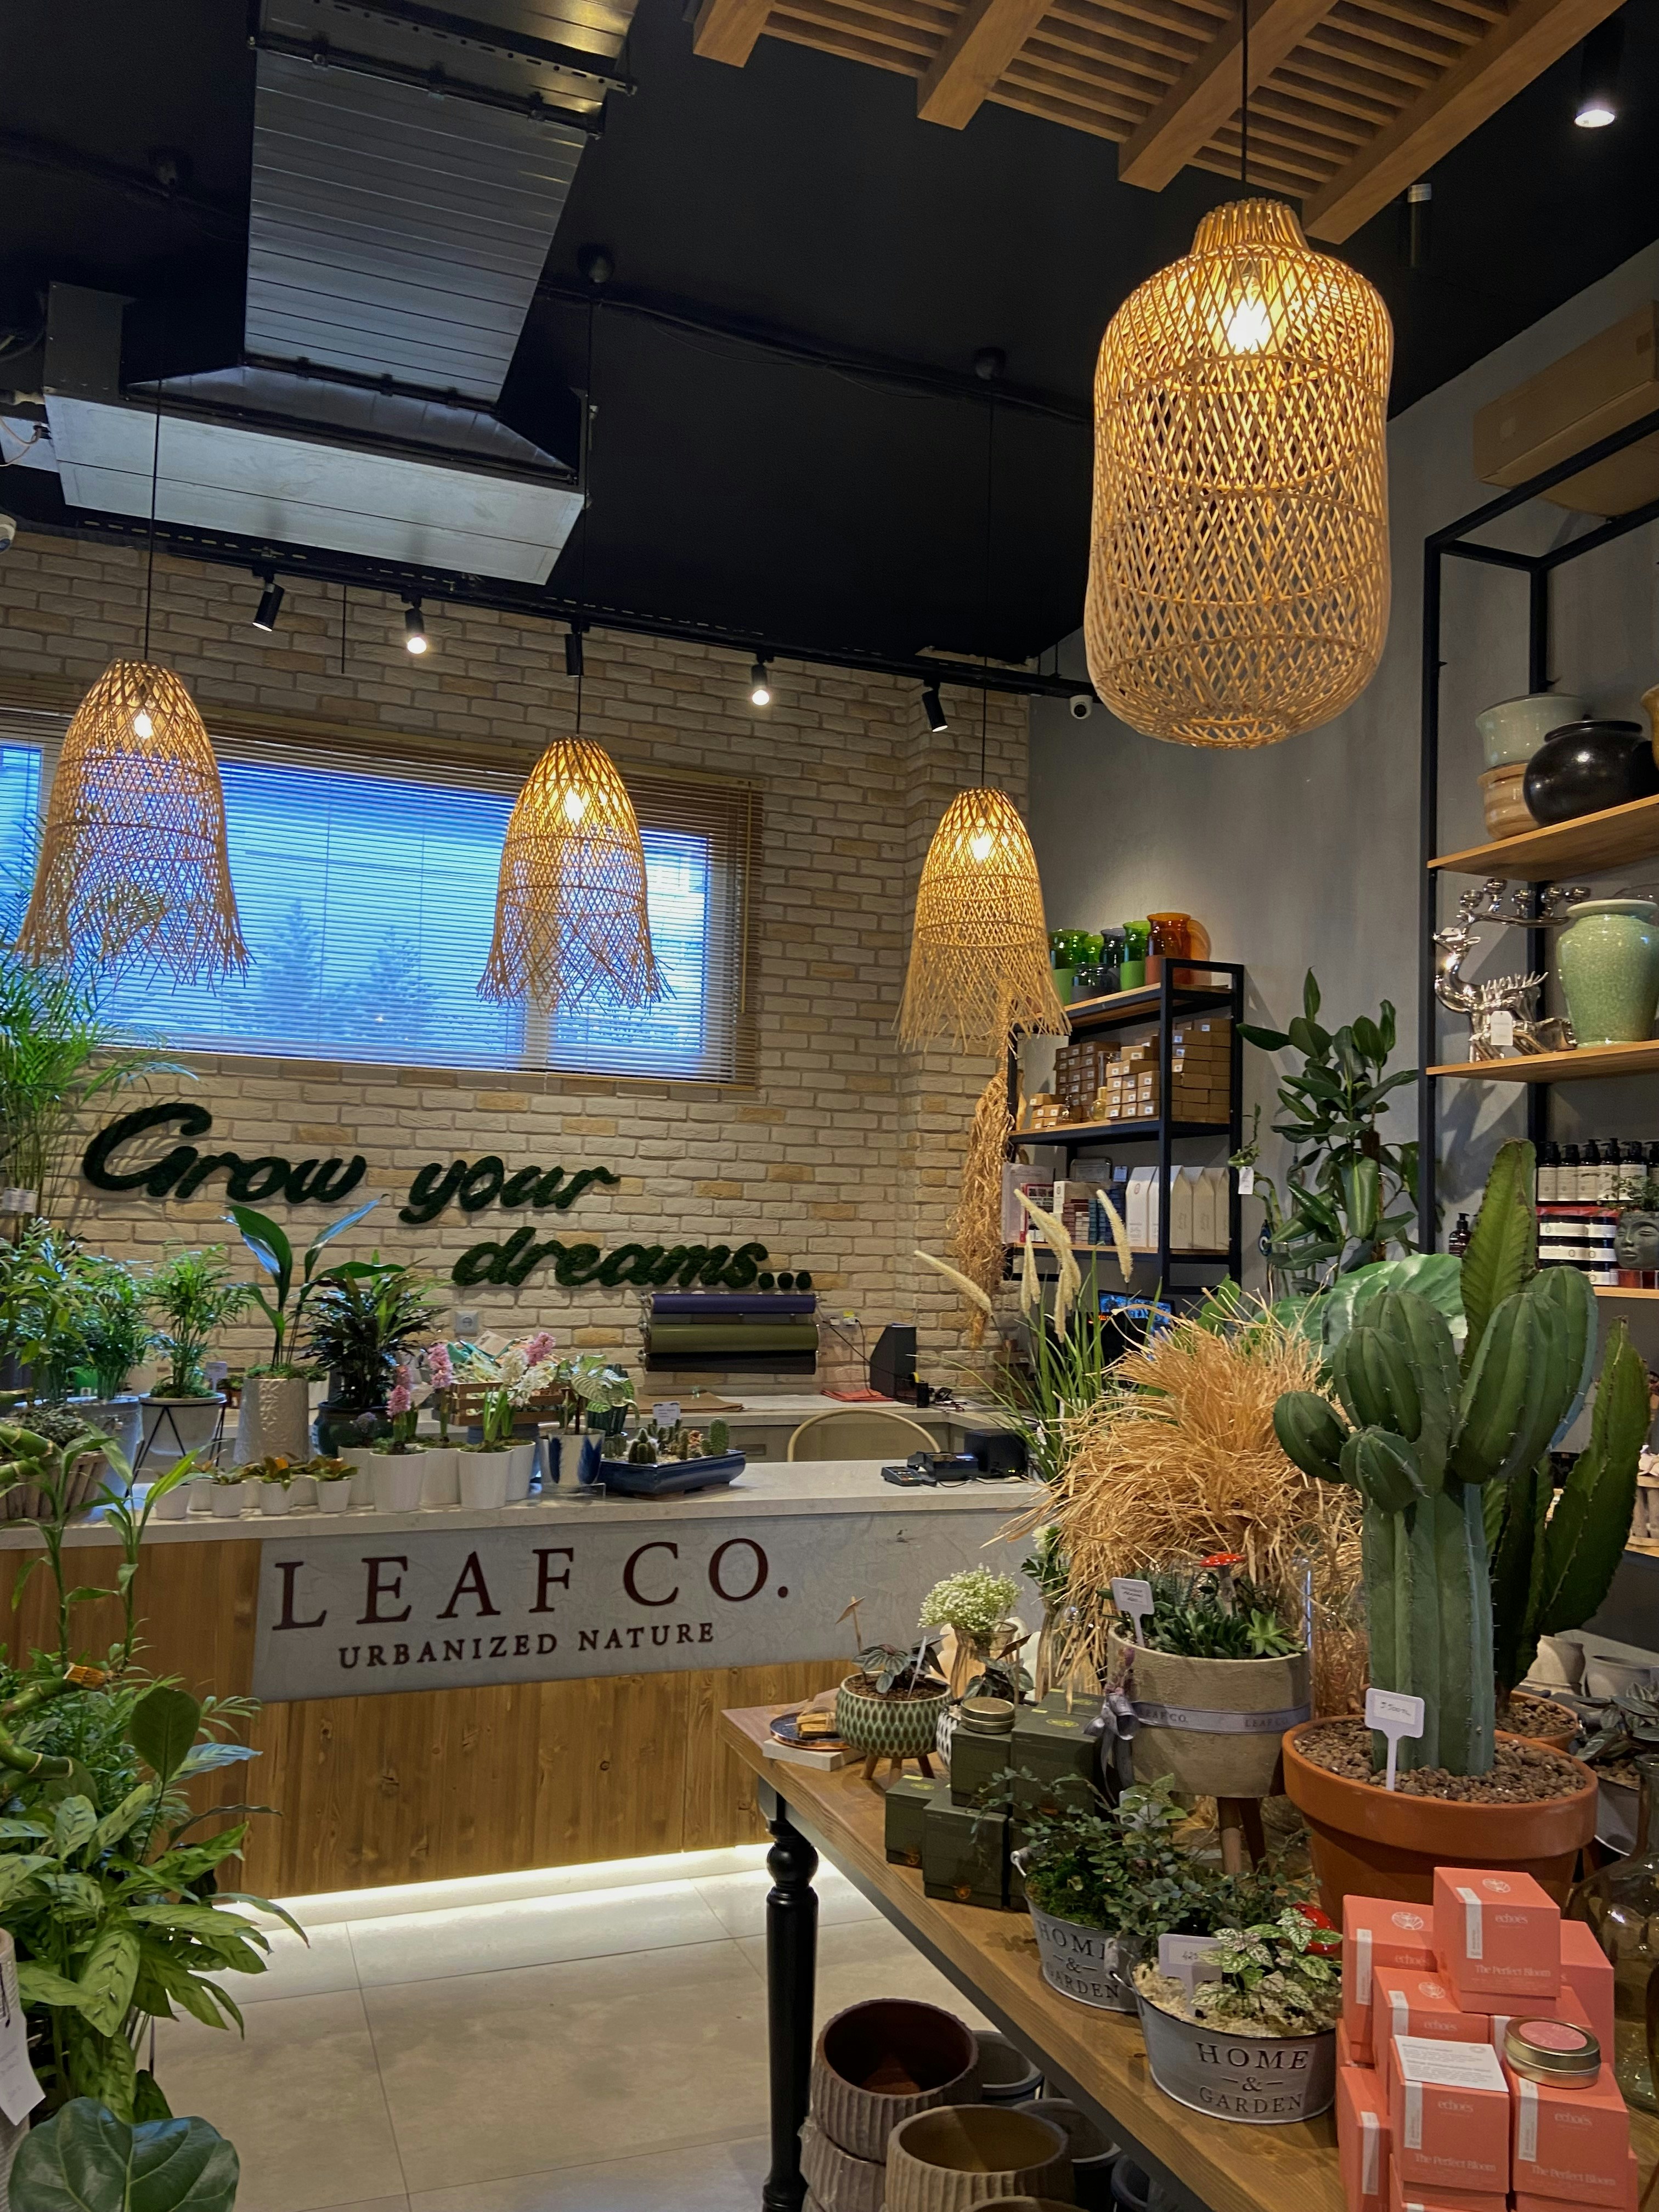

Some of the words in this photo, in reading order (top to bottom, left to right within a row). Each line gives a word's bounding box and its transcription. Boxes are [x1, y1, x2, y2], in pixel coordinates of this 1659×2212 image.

[82, 1102, 368, 1204] Grow
[399, 1154, 622, 1225] your
[450, 1226, 813, 1290] dreams...
[272, 1547, 575, 1632] LEAF
[622, 1537, 789, 1607] CO.
[338, 1633, 557, 1669] URBANIZED
[578, 1622, 715, 1651] NATURE
[1245, 1718, 1271, 1728] LEAF
[1474, 1964, 1492, 1974] The
[1195, 2042, 1309, 2069] HOME
[1199, 2086, 1303, 2113] GARDEN
[1414, 2152, 1432, 2163] The
